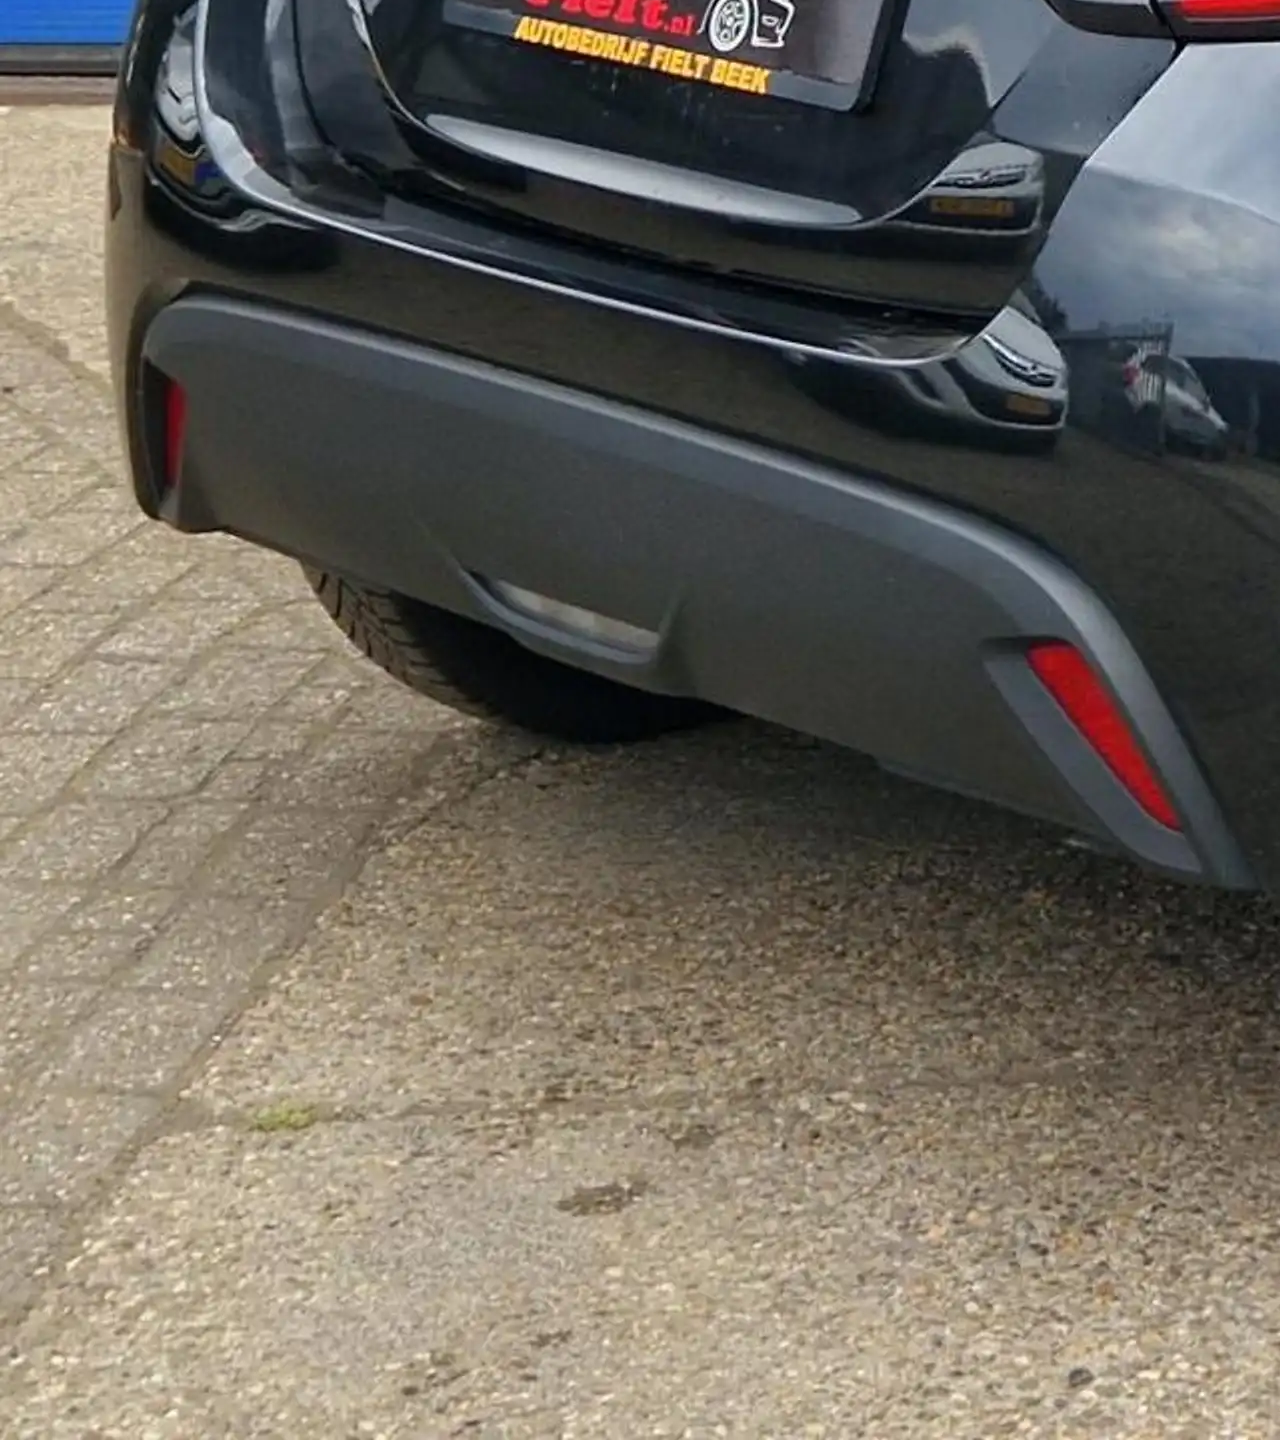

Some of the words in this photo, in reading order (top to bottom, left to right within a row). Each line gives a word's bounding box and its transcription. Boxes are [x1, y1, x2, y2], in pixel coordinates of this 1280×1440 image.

[514, 15, 649, 67] AUTOBEDRIJF
[649, 45, 709, 79] FIELT
[708, 58, 771, 93] BEEK
